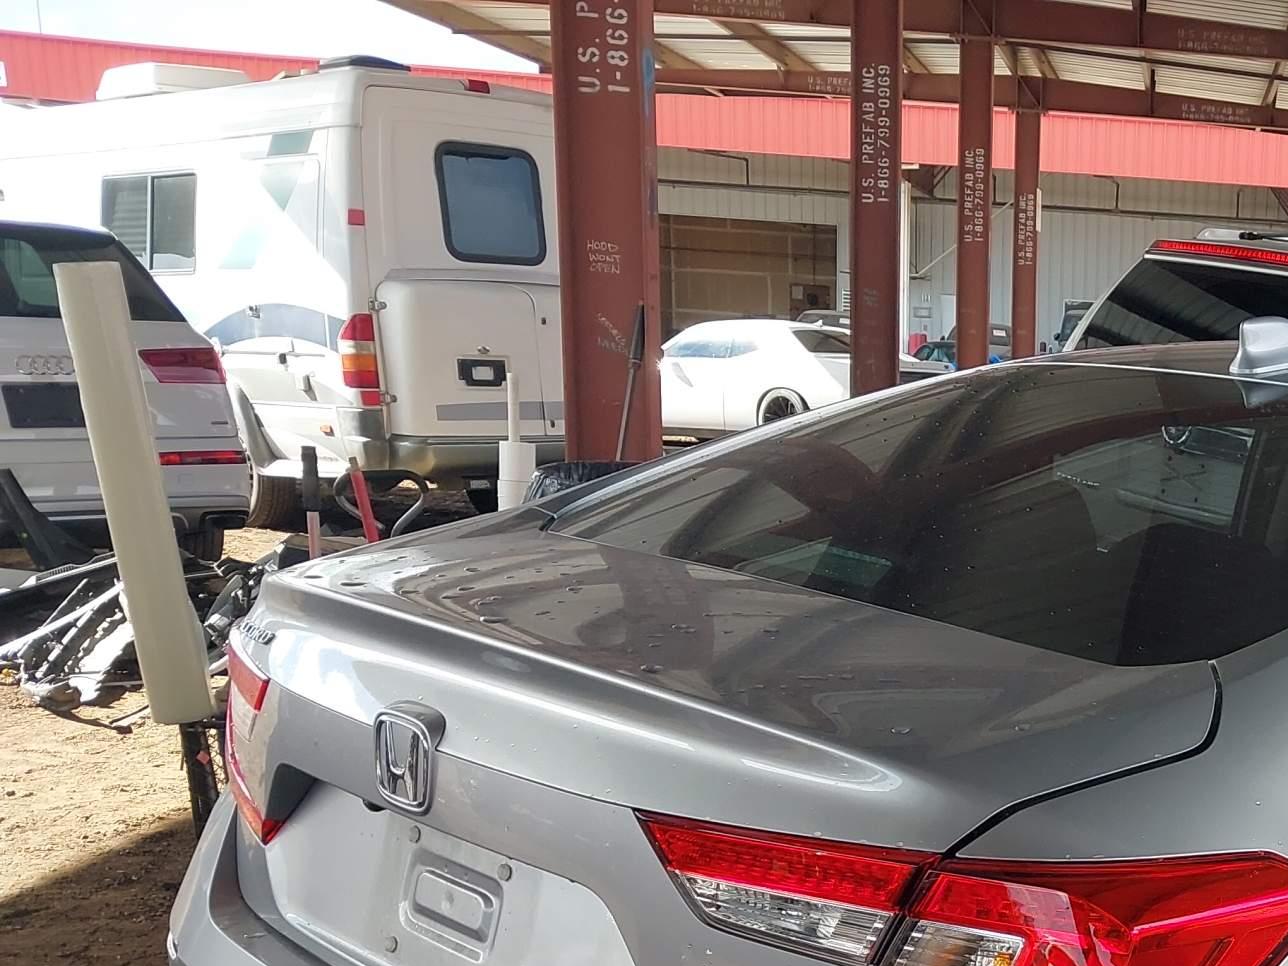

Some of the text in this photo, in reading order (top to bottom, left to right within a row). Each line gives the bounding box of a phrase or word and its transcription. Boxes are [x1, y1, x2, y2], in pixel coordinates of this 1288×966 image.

[578, 39, 600, 93] U.S.
[862, 63, 875, 203] U.S. PREFAB INC.
[877, 65, 890, 202] 1-866-799-0969
[964, 173, 974, 216] PREFAB
